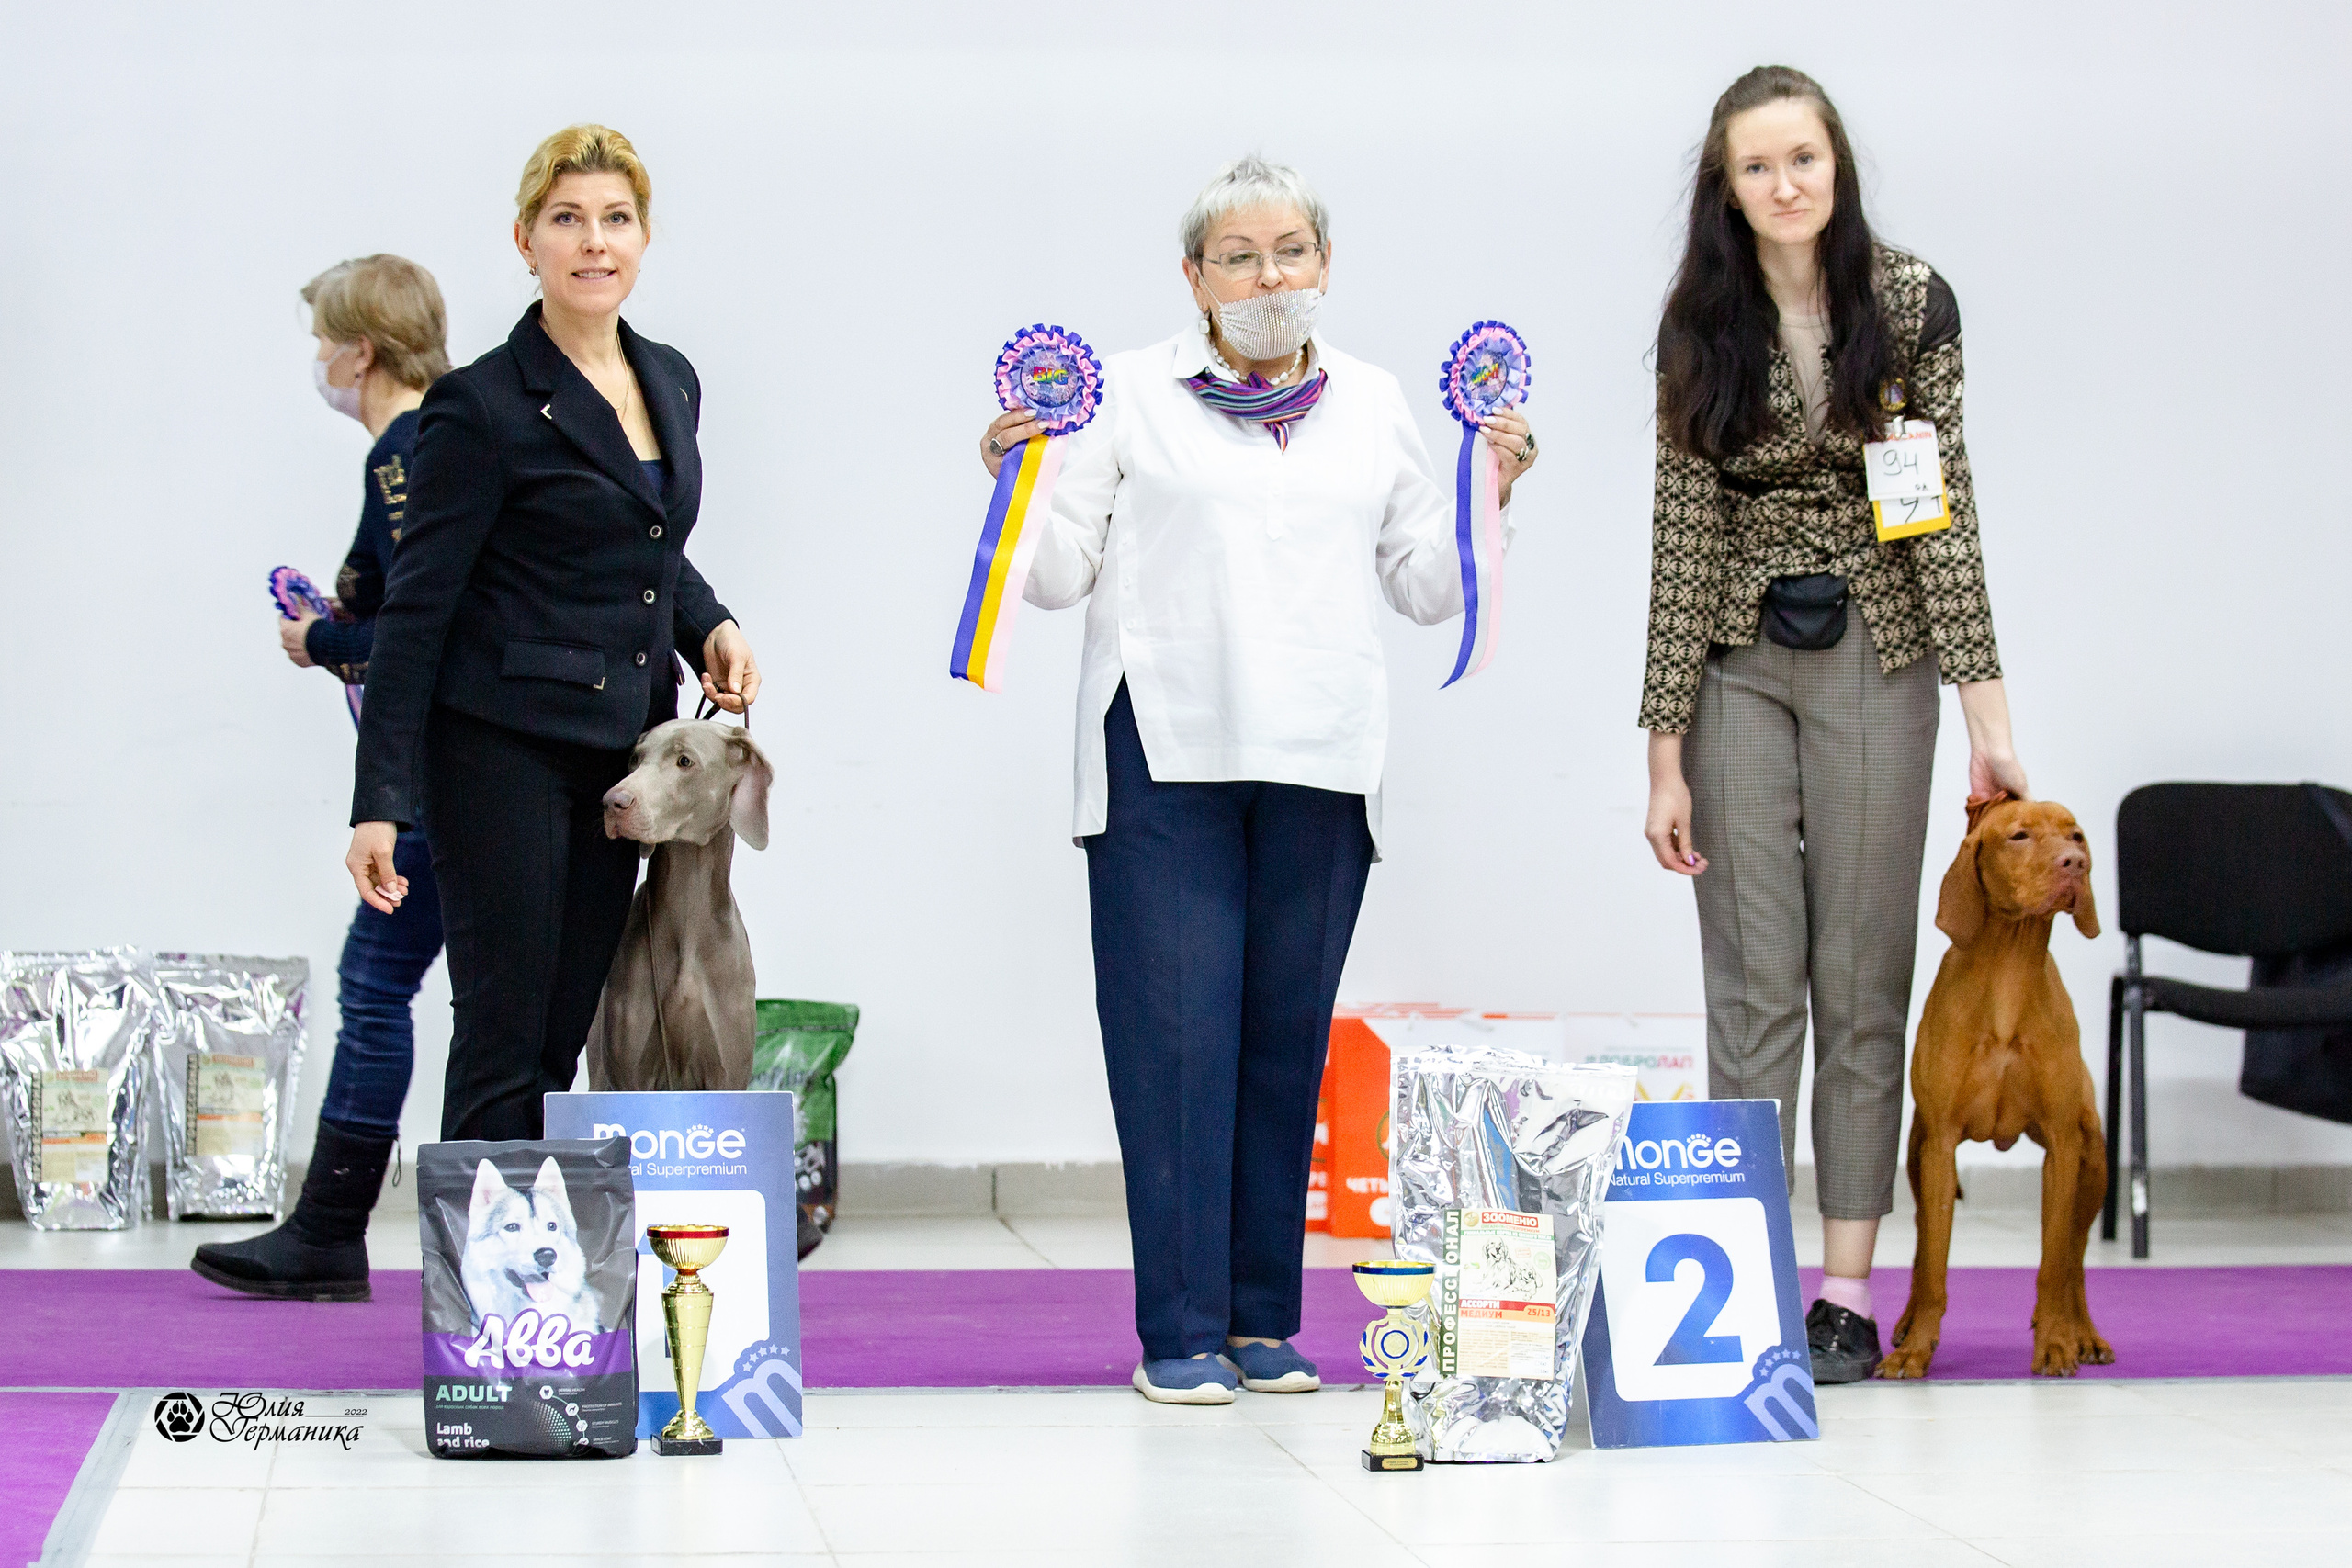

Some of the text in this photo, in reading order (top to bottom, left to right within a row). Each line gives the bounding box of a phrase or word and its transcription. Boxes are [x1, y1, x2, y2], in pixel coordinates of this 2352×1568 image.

[1033, 366, 1069, 385] BIG
[1883, 449, 1919, 476] 94
[647, 1162, 747, 1178] Superpremium
[1610, 1170, 1745, 1187] Natural Superpremium
[1483, 1213, 1537, 1227] ЗООМЕНЮ
[1460, 1299, 1500, 1309] АССОРТИ
[1645, 1233, 1744, 1366] 2
[1460, 1308, 1551, 1319] МЕДИУМ 25/13
[435, 1384, 513, 1402] ADULT
[436, 1422, 472, 1435] Lamb
[437, 1437, 490, 1448] and rice
